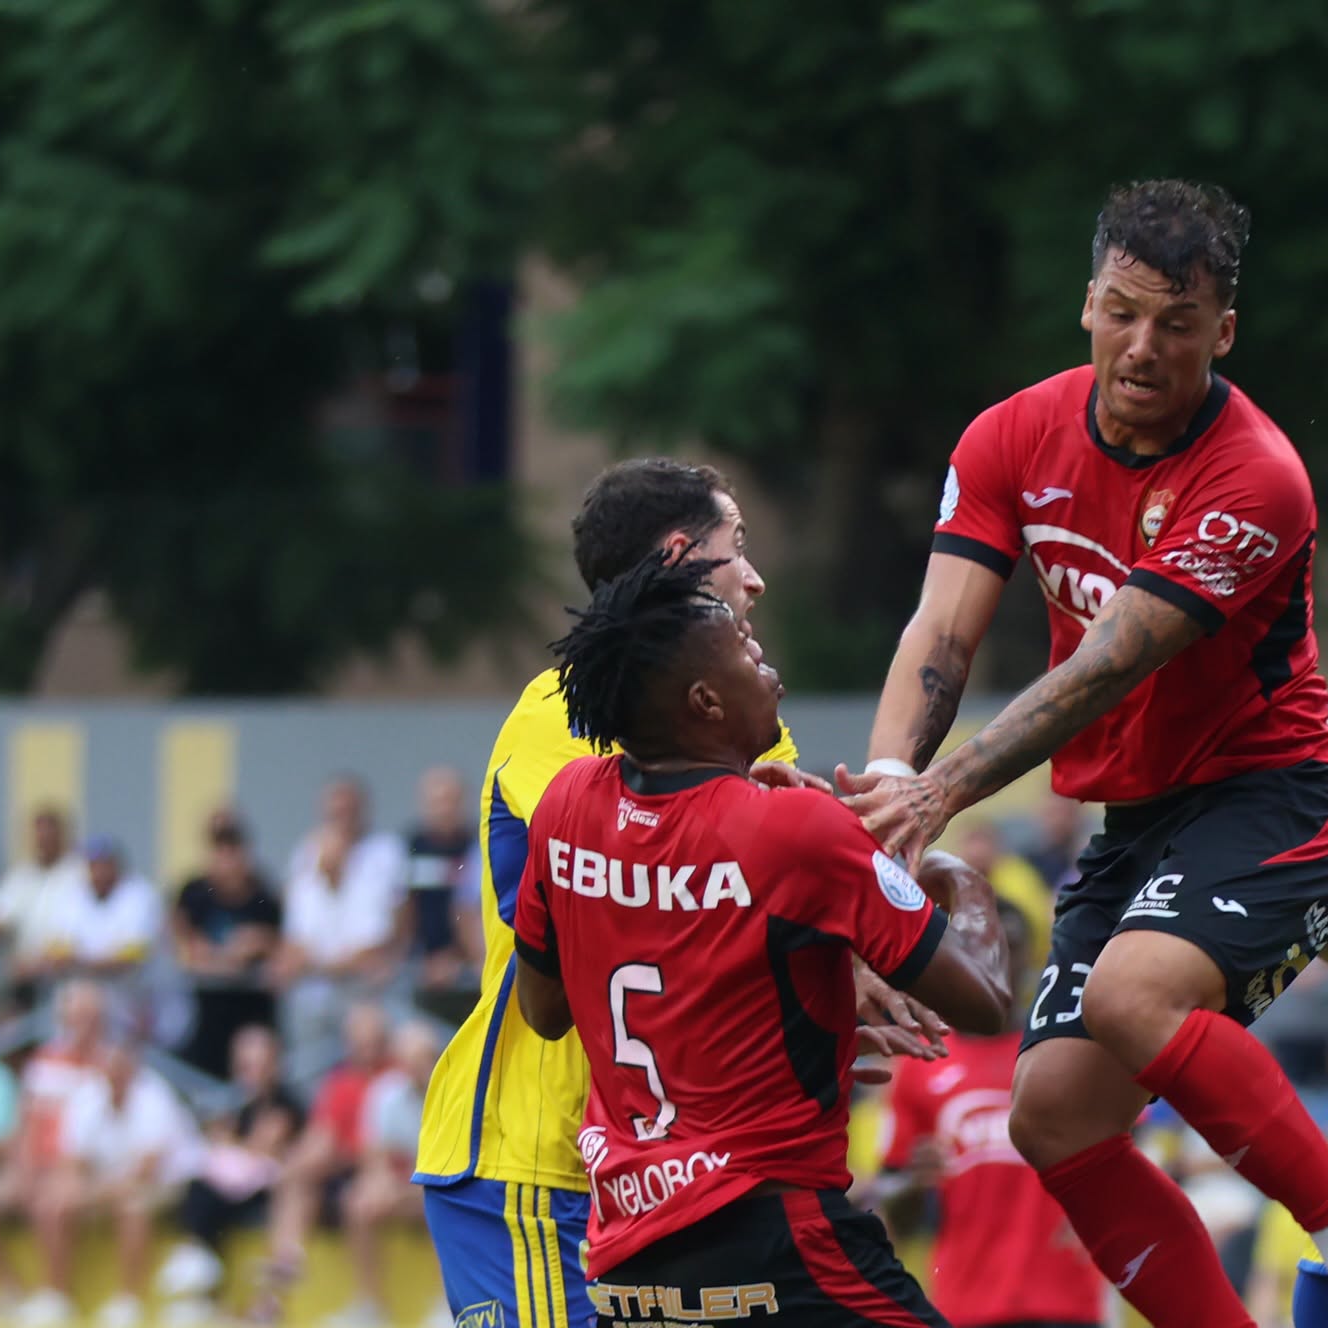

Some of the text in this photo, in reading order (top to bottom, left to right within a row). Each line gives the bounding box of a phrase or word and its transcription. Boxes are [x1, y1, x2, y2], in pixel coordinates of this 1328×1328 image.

[547, 837, 752, 912] EBUKA
[608, 963, 678, 1141] 5
[586, 1281, 779, 1321] ETAILER
